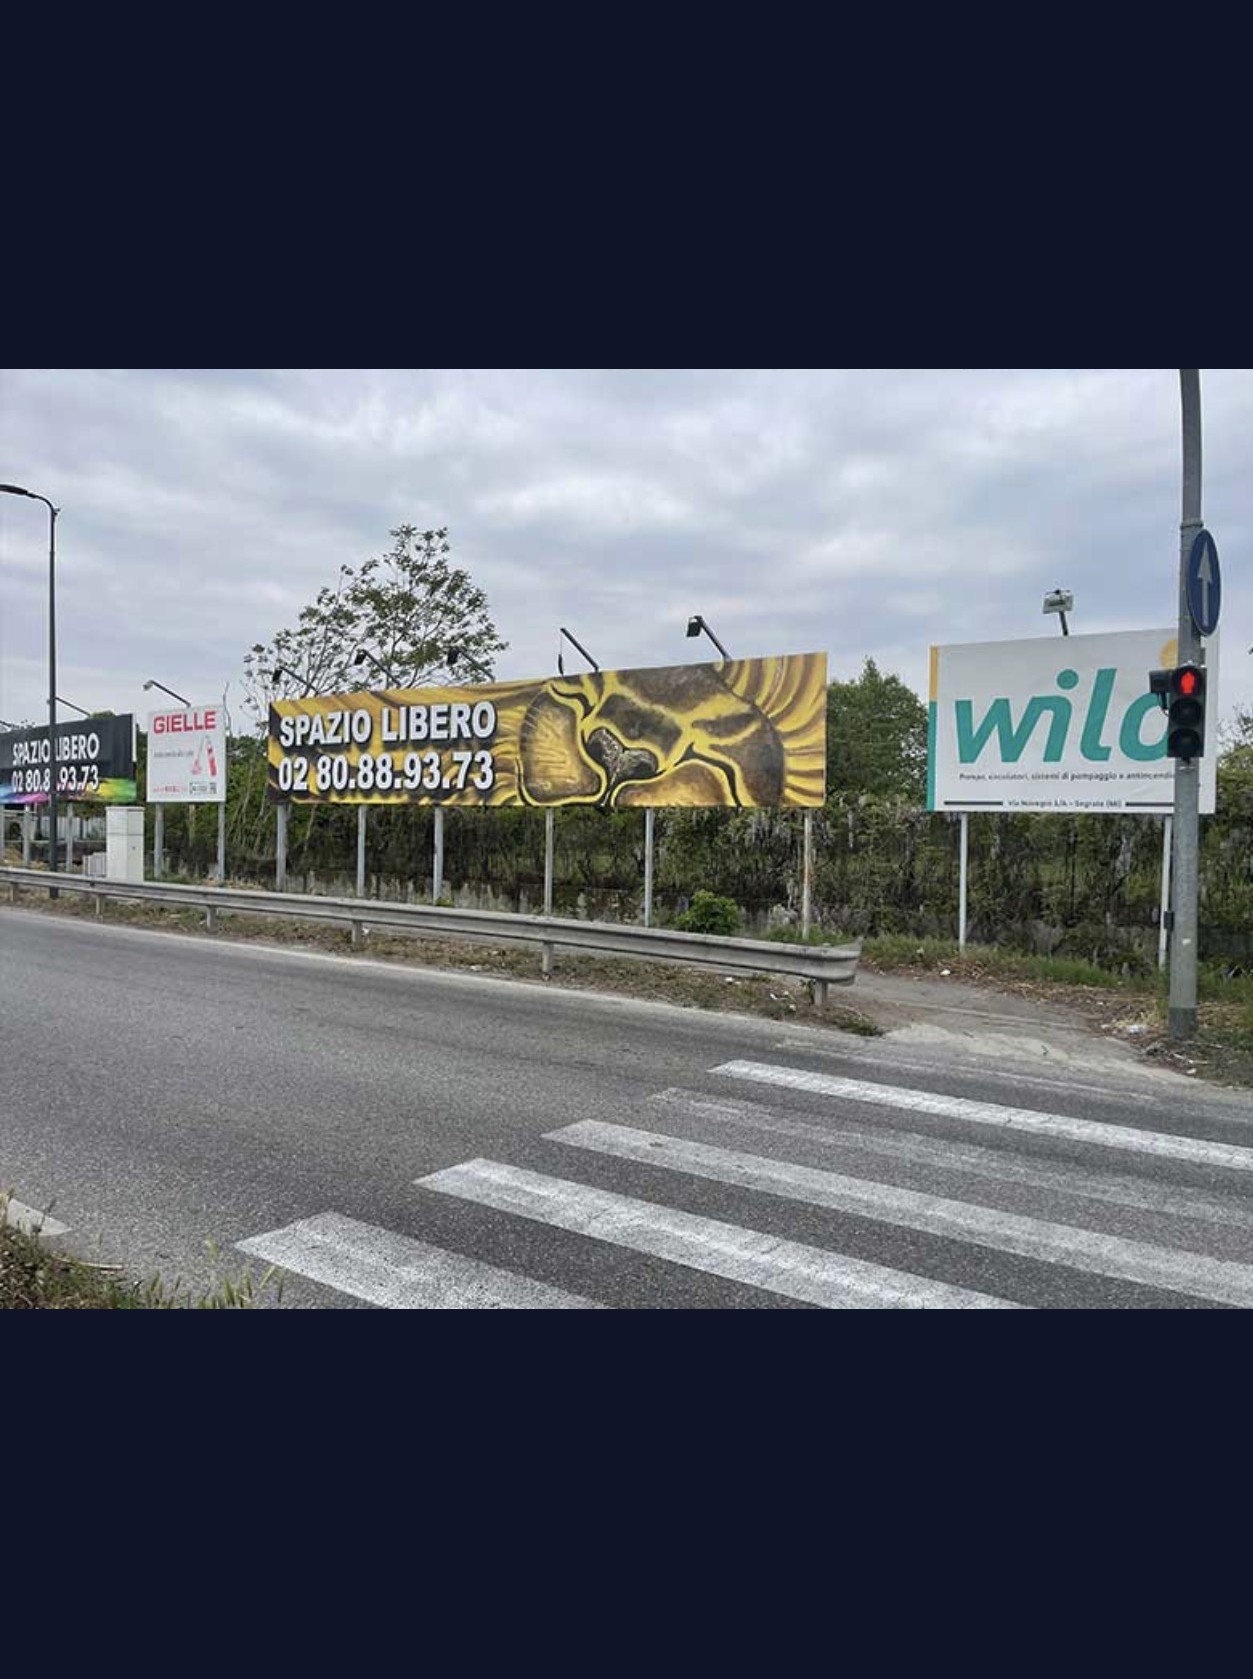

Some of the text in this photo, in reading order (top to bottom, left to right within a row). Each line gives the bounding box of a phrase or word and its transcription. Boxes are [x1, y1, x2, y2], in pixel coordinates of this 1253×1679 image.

[153, 711, 217, 733] GIELLE
[280, 701, 495, 747] SPAZIO LIBERO
[12, 738, 50, 766] SPAZIO
[11, 764, 99, 793] 02 80.8.93.73
[278, 750, 494, 791] 02 80.88.93.73
[1031, 772, 1060, 781] sistemi
[1061, 771, 1070, 780] di
[1070, 772, 1117, 782] pompaggio
